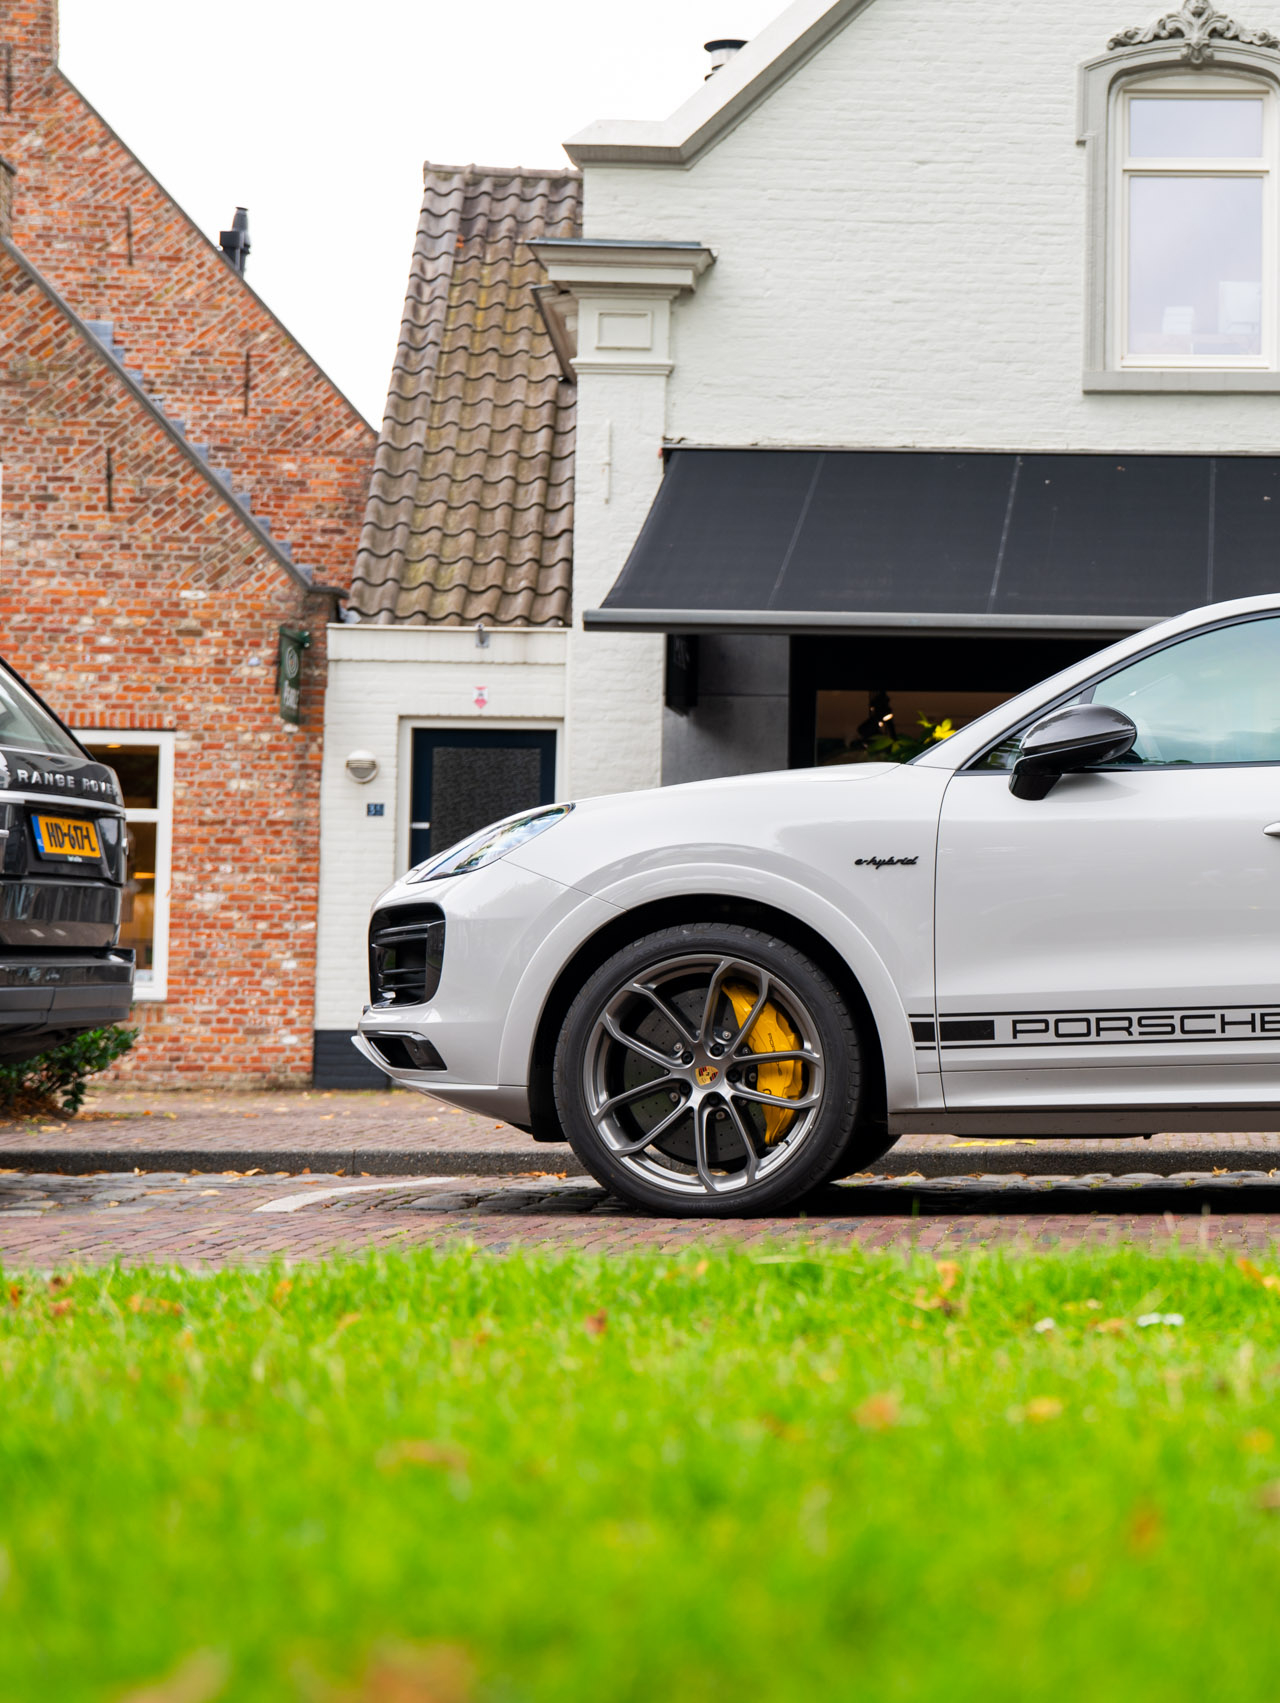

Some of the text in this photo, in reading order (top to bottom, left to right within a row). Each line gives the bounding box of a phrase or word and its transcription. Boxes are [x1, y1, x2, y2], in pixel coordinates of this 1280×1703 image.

[17, 769, 118, 797] RANGE ROVER
[45, 822, 96, 852] HD-617-L
[854, 856, 919, 870] e-hybrid
